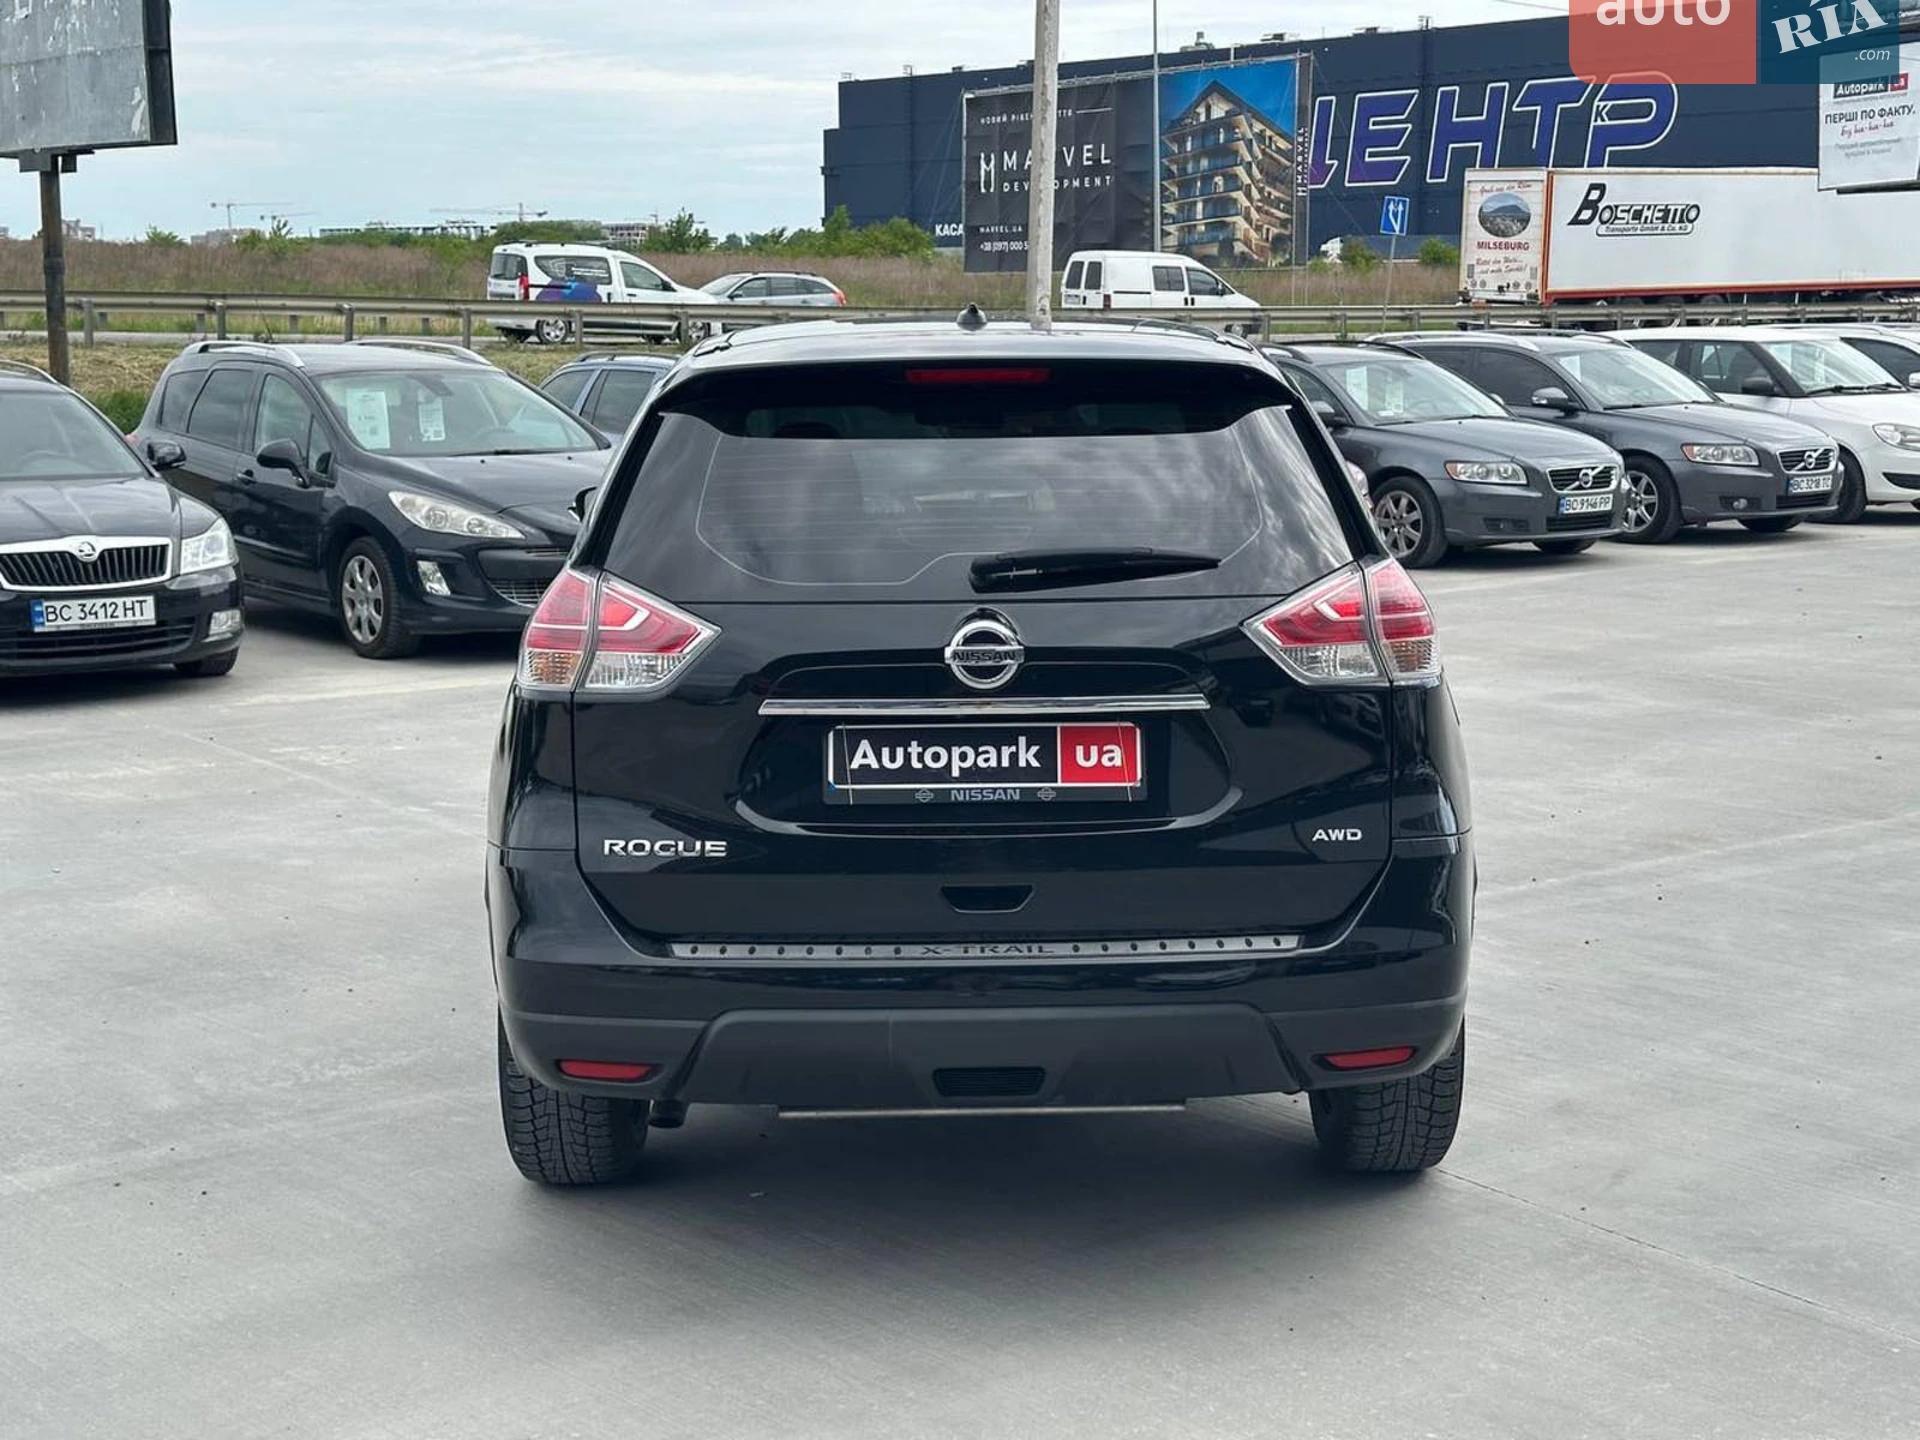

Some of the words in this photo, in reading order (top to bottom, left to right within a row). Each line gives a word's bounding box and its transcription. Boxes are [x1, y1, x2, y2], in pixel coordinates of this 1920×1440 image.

[1825, 111, 1858, 125] ПЕРШІ
[1860, 108, 1876, 121] ПО
[1003, 143, 1111, 171] MAVEL
[1003, 175, 1112, 193] DEVOPMENT
[1567, 183, 1700, 226] BOSCHETTO
[1476, 241, 1530, 251] MILSEBURG
[45, 604, 72, 623] BC
[78, 601, 119, 621] 3412
[123, 599, 147, 618] HT
[952, 650, 1017, 662] NISSAN
[851, 736, 1041, 777] Autopark
[1075, 744, 1122, 768] ua
[951, 788, 1020, 801] NISSAN
[1312, 828, 1362, 842] AWD
[603, 839, 727, 857] ROGUE
[921, 944, 1055, 955] X-TRAIL
